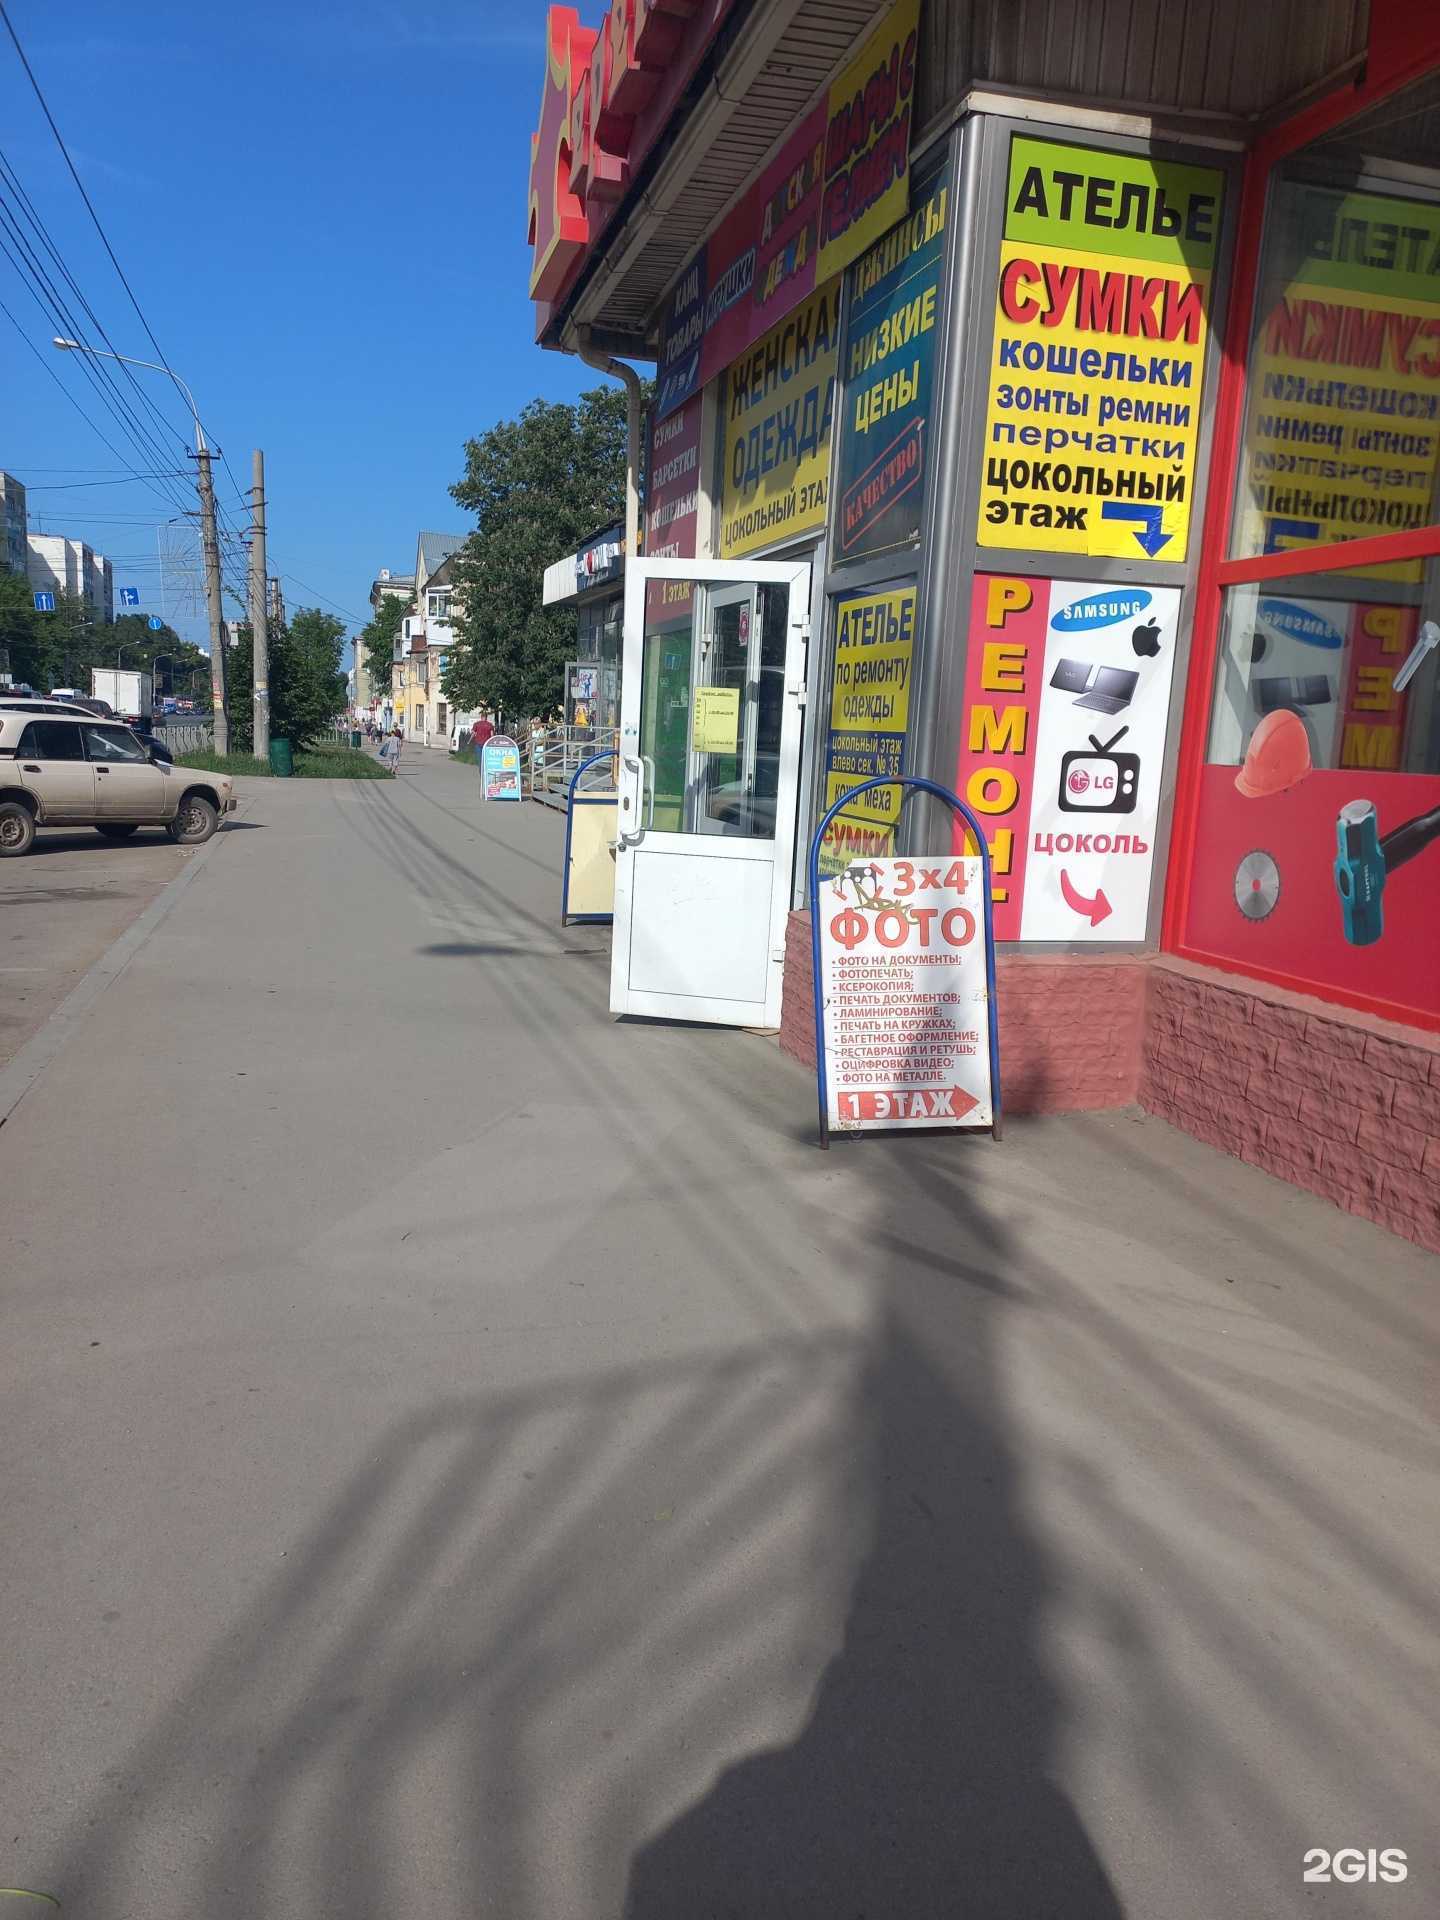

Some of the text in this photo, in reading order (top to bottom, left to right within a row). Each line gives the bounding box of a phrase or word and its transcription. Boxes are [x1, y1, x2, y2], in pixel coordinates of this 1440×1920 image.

[1013, 166, 1216, 243] АТЕЛЬЕ
[1000, 258, 1204, 346] СУМКИ
[850, 284, 937, 379] НИЗКИЕ
[855, 359, 920, 434] ЦЕНЫ
[654, 411, 685, 449] СУМКИ
[993, 422, 1186, 460] перчатки
[652, 446, 697, 490] БАРСЕТКИ
[847, 439, 917, 532] КАЧЕСТВО
[650, 489, 698, 532] КОШЕЛЬКИ
[725, 477, 829, 548] ЦОКОЛЬНЫЙ ЭТА
[838, 599, 913, 649] АТЕЛЬЕ
[1063, 601, 1141, 620] SAMSUNG
[836, 655, 910, 692] по ремонту
[843, 694, 895, 723] одежды
[888, 757, 900, 776] 35
[1094, 776, 1114, 789] LG
[1034, 833, 1149, 856] ЦОКОЛЬ
[830, 907, 976, 950] ФОТО
[838, 955, 962, 967] ФОТО НА ДОКУМЕНТЫ;
[838, 968, 914, 979] ФОТОПЕЧАТЬ;
[838, 982, 914, 992] КСЕРОКОПИЯ;
[839, 993, 961, 1006] ПЕЧАТЬ ДОКУМЕНТОВ;
[839, 1006, 943, 1018] ЛАМИНИРОВАНИЕ;
[840, 1018, 956, 1031] ПЕЧАТЬ НА КРУЖКАХ;
[840, 1031, 979, 1044] БАГЕТНОЕ ОФОРМЛЕНИЕ;
[841, 1044, 977, 1058] РЕСТАВРАЦИЯ И РЕТУШЬ;
[841, 1057, 955, 1071] ОЦИФРОВКА ВИДЕО;
[842, 1073, 873, 1083] ФОТО
[875, 1072, 890, 1082] НА
[848, 1091, 956, 1119] 1 ЭТАЖ
